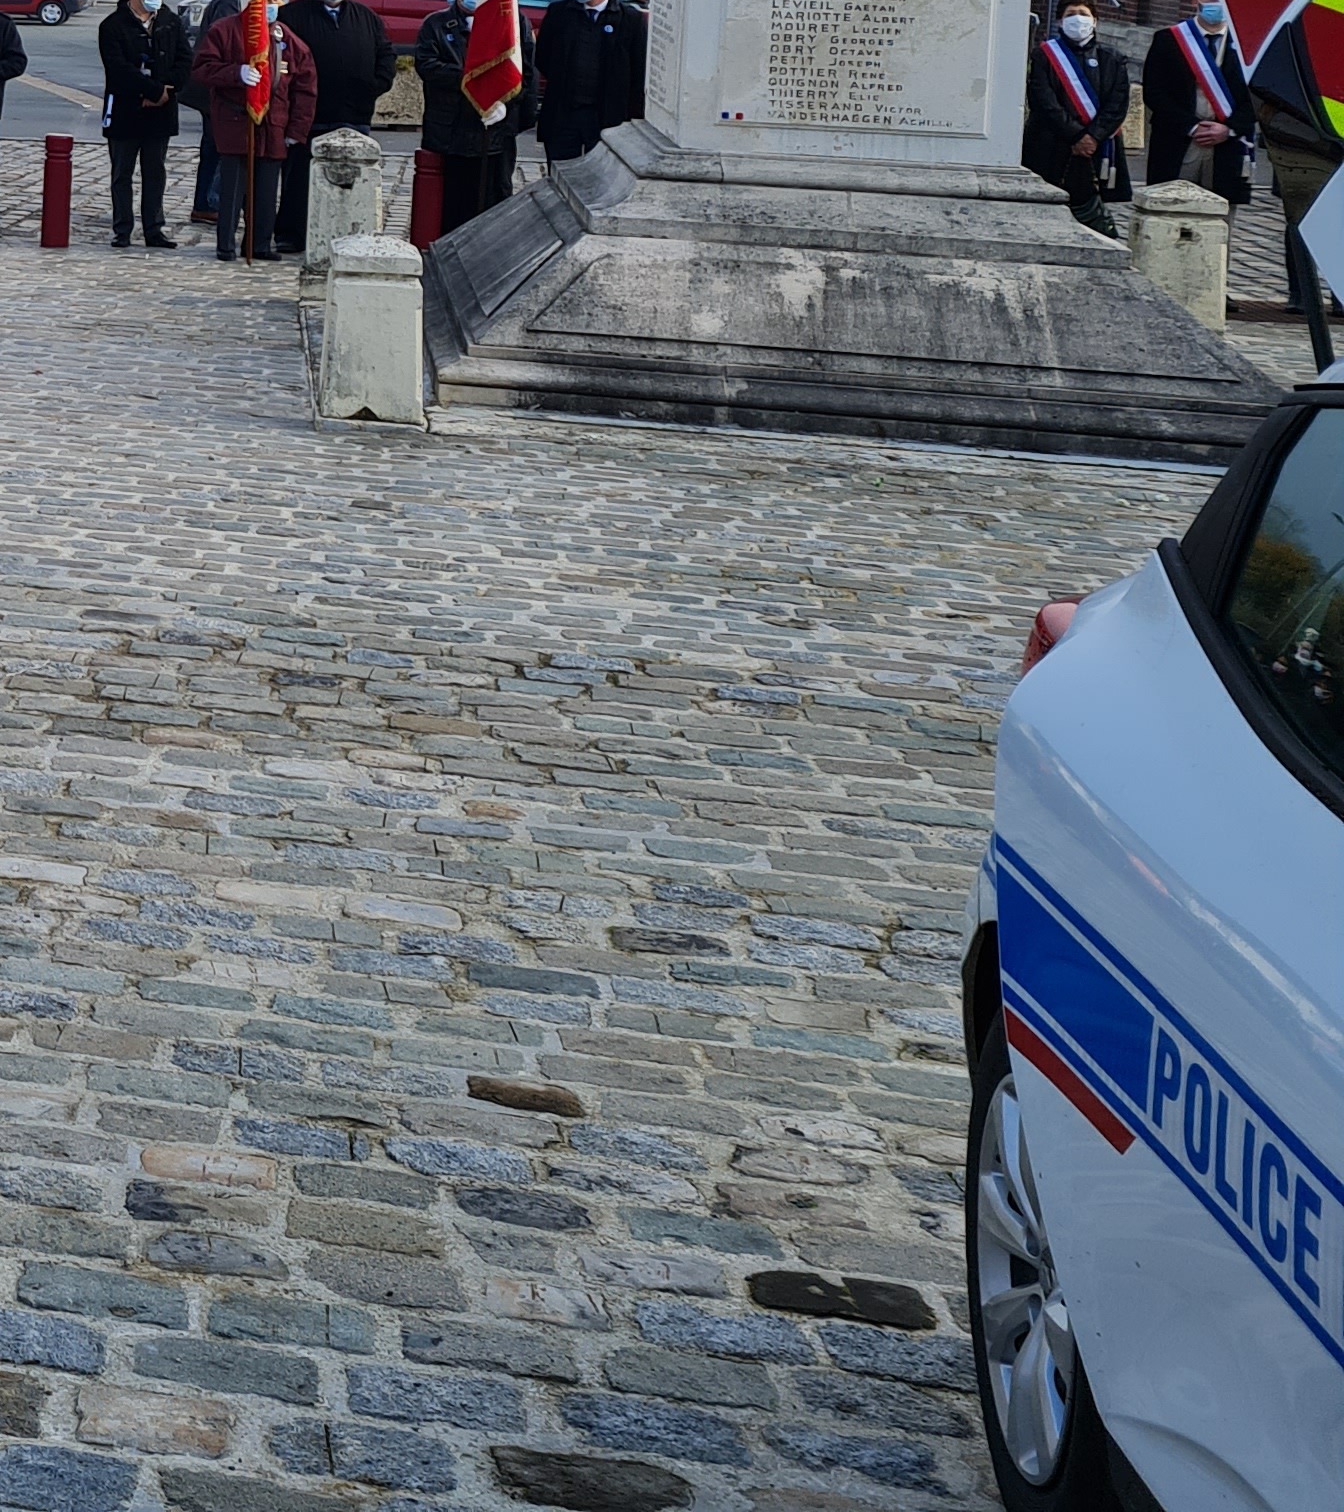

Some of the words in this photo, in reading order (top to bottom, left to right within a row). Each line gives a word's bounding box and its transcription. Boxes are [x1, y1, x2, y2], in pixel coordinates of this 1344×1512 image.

[772, 0, 834, 10] LEVIEIL
[771, 11, 851, 22] MARIOTTE
[862, 13, 916, 24] ALBERT
[771, 22, 840, 33] MOURET
[853, 26, 902, 36] LUCIEN
[771, 33, 817, 43] OBRY
[830, 35, 895, 46] GEORGES
[770, 44, 816, 55] OBRY
[829, 47, 882, 57] OCTAVE
[769, 56, 815, 65] PETIT
[829, 57, 881, 68] JOSEPH
[769, 66, 837, 78] POTTIER
[768, 78, 840, 89] QUIGNON
[850, 81, 903, 92] ALFRED
[768, 89, 839, 99] THIERRY
[769, 100, 863, 112] TISSERAND
[874, 104, 922, 116] VICTOR
[1152, 1026, 1322, 1308] POLICE
